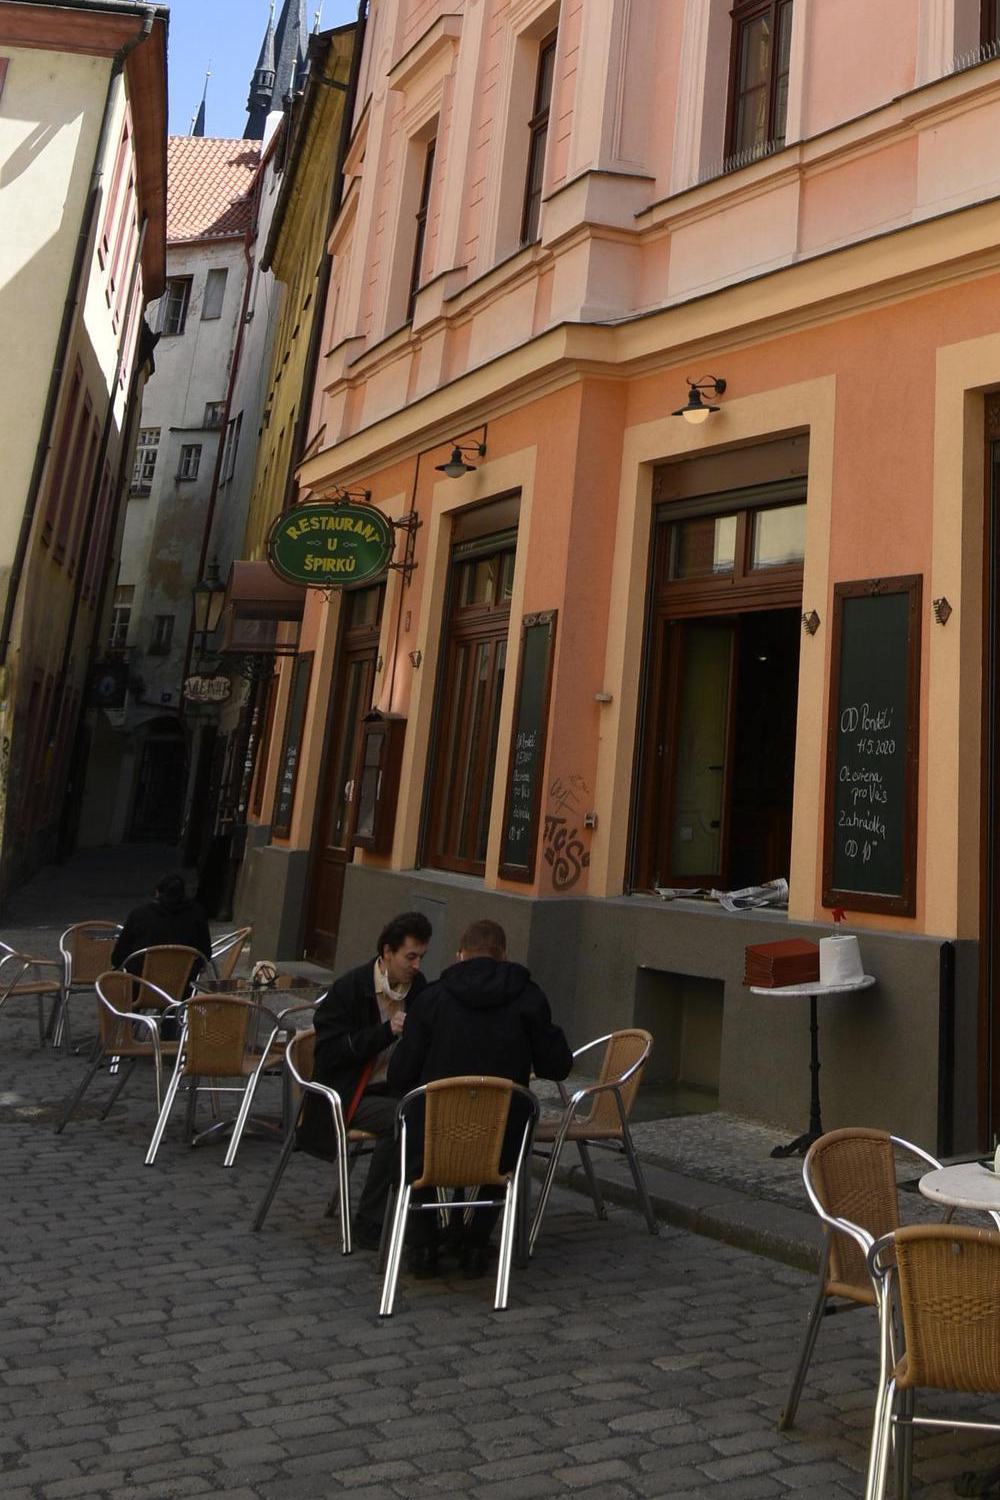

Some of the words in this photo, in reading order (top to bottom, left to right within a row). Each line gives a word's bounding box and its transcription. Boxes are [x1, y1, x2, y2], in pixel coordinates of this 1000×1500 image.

[286, 516, 380, 543] RESTAURANT
[327, 538, 338, 551] U
[303, 554, 357, 572] ŠPIRKŮ
[840, 707, 859, 733] OD
[851, 786, 868, 805] pro
